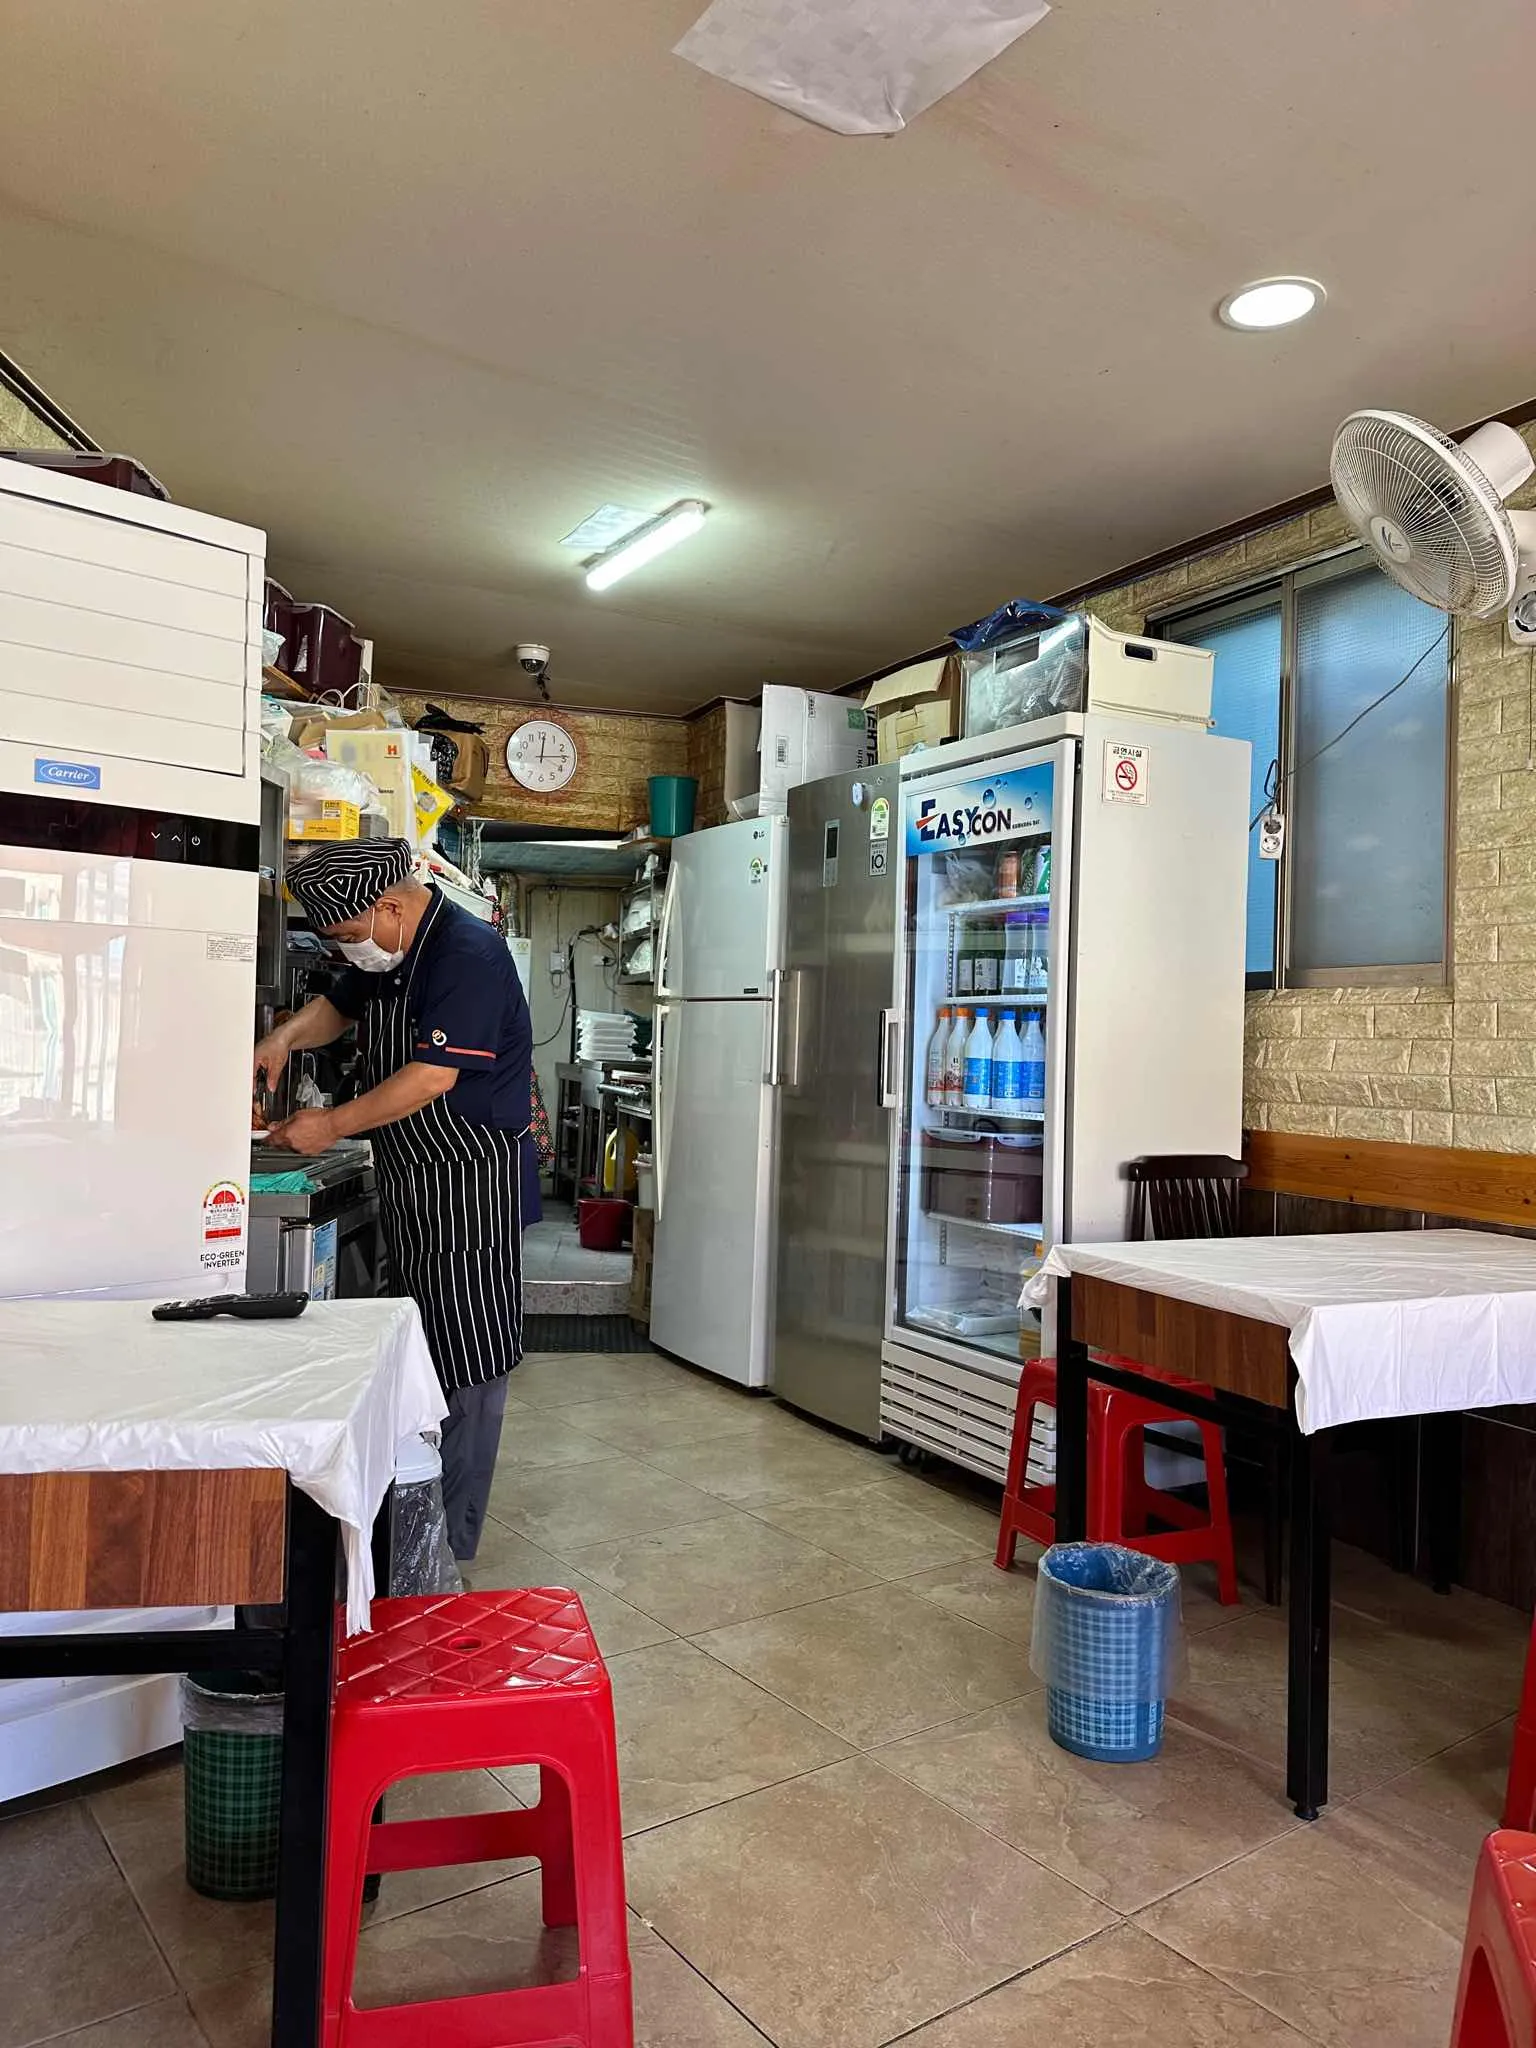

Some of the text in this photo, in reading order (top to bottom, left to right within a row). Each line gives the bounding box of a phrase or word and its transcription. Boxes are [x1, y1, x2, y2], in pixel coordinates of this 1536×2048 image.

[528, 734, 534, 742] 11
[560, 743, 565, 752] 2
[1112, 746, 1142, 758] 금연시설
[48, 766, 89, 781] Carrier
[528, 771, 533, 779] 7
[538, 773, 544, 782] 6
[550, 772, 556, 780] 5
[200, 1250, 245, 1262] ECO-GREEN
[203, 1258, 241, 1270] INVERTER
